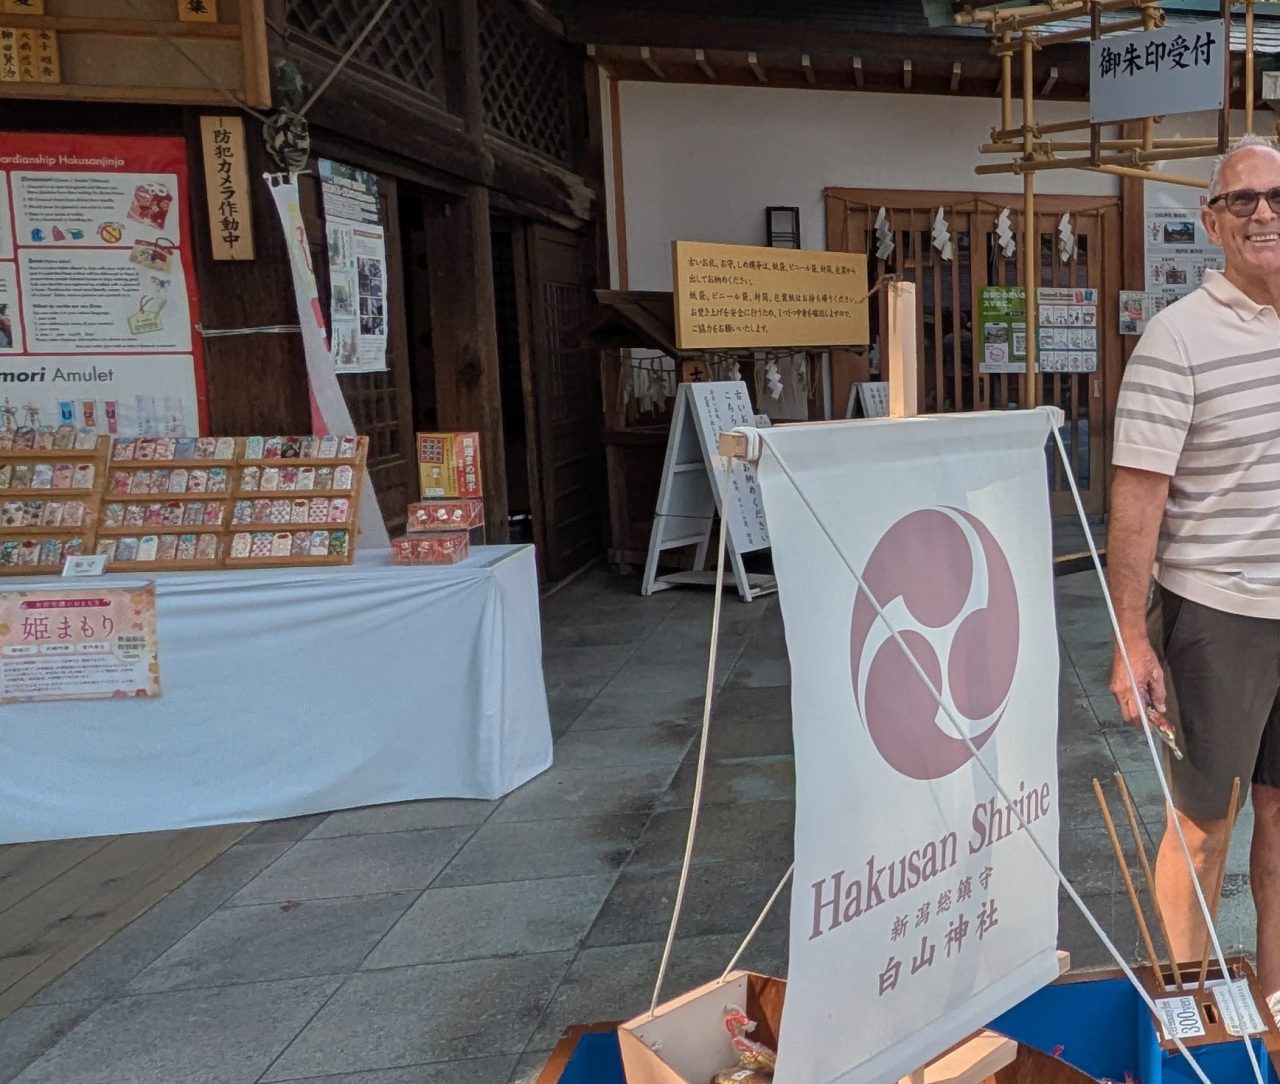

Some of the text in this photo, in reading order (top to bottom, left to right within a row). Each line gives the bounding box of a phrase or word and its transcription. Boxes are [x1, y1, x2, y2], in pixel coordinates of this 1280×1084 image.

[1098, 31, 1216, 79] 御朱印受付
[0, 154, 125, 168] ardianship Hakusanjinja
[213, 128, 242, 249] 防犯カメラ作動中
[52, 366, 114, 382] Amulet
[21, 615, 114, 640] 姫まもり
[808, 780, 1050, 941] Hakusan Shrine
[890, 866, 993, 942] 新潟総鎮守
[878, 899, 999, 997] 白山神社
